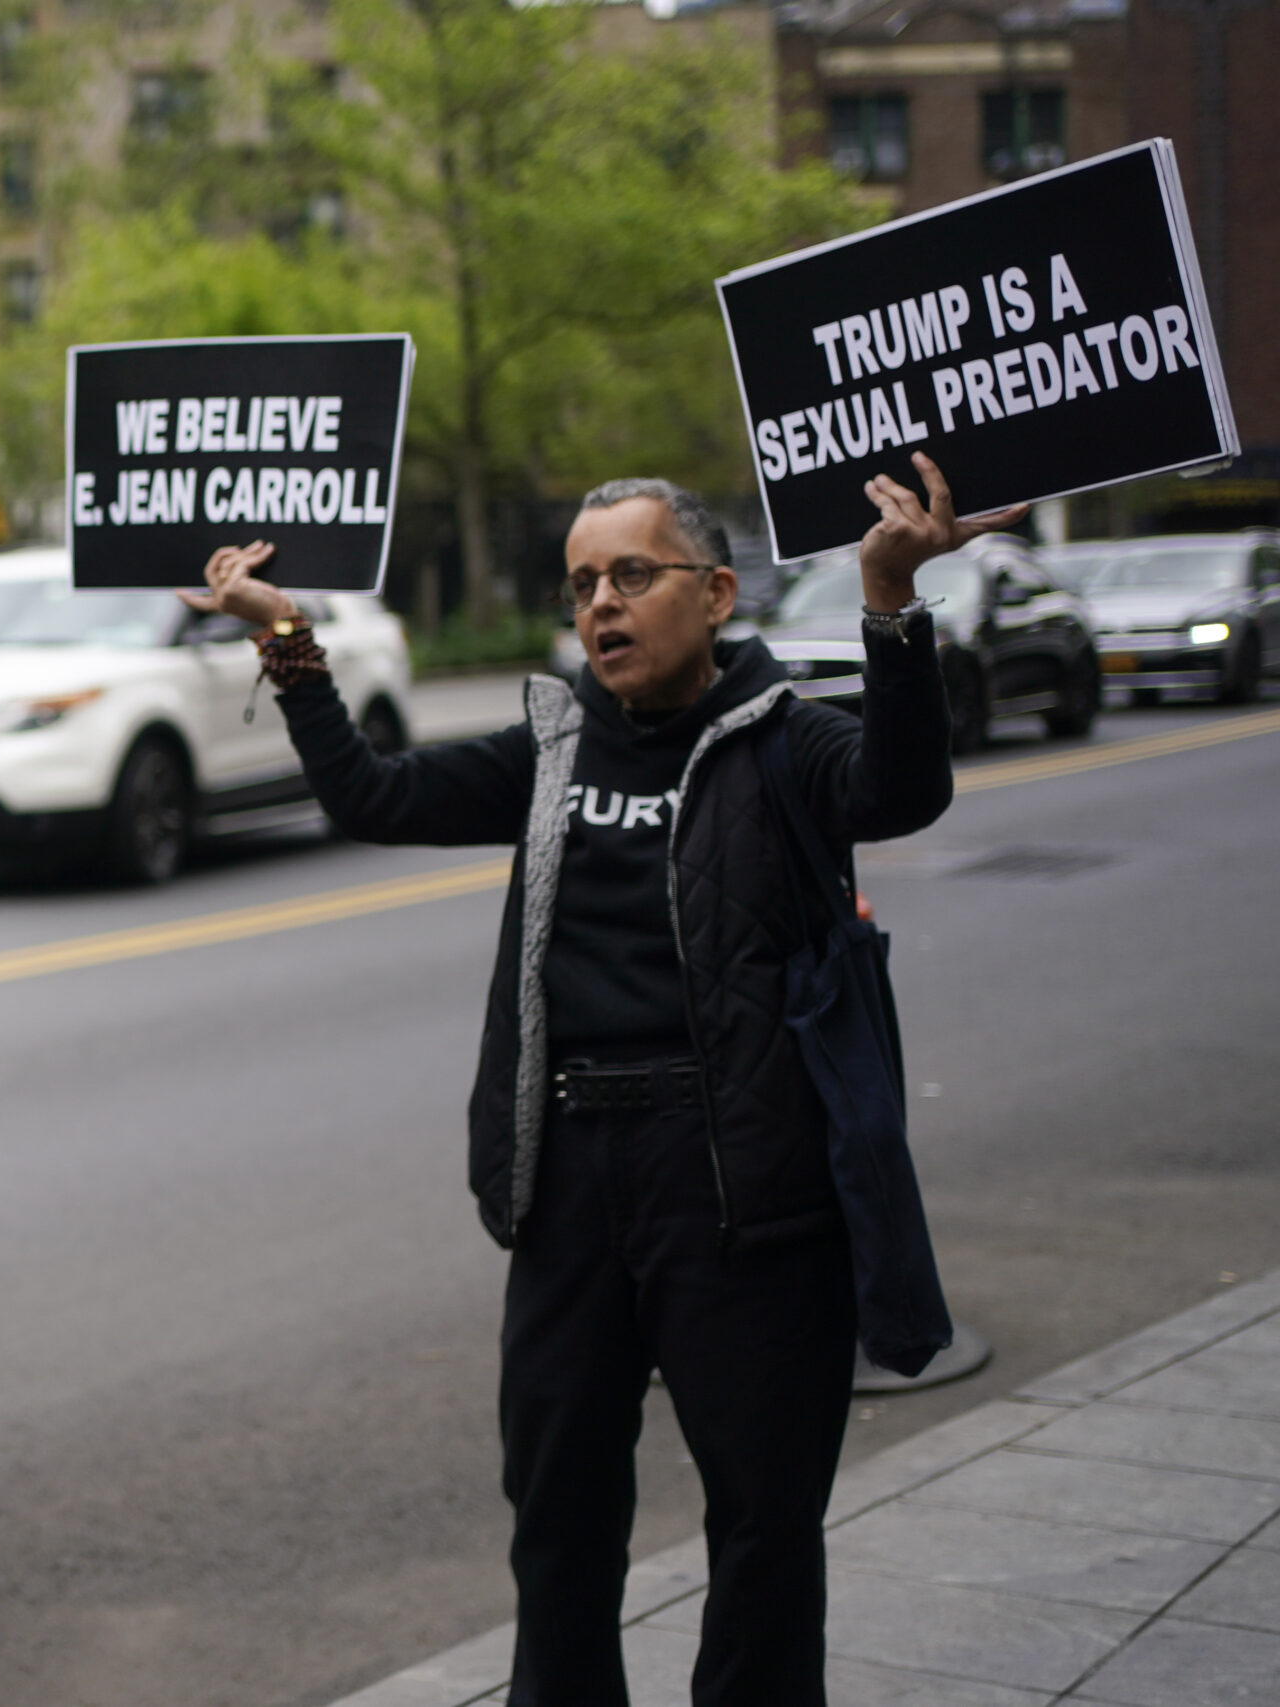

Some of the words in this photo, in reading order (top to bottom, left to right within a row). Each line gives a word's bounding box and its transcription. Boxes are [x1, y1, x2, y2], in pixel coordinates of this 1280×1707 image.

[813, 285, 970, 386] TRUMP
[983, 266, 1036, 338] IS
[1051, 253, 1088, 323] A
[116, 399, 170, 455] WE
[175, 396, 343, 453] BELIEVE
[756, 382, 929, 481] SEXUAL
[932, 304, 1200, 433] PREDATOR
[73, 472, 104, 526] E.
[108, 467, 197, 526] JEAN
[203, 467, 387, 525] CARROLL
